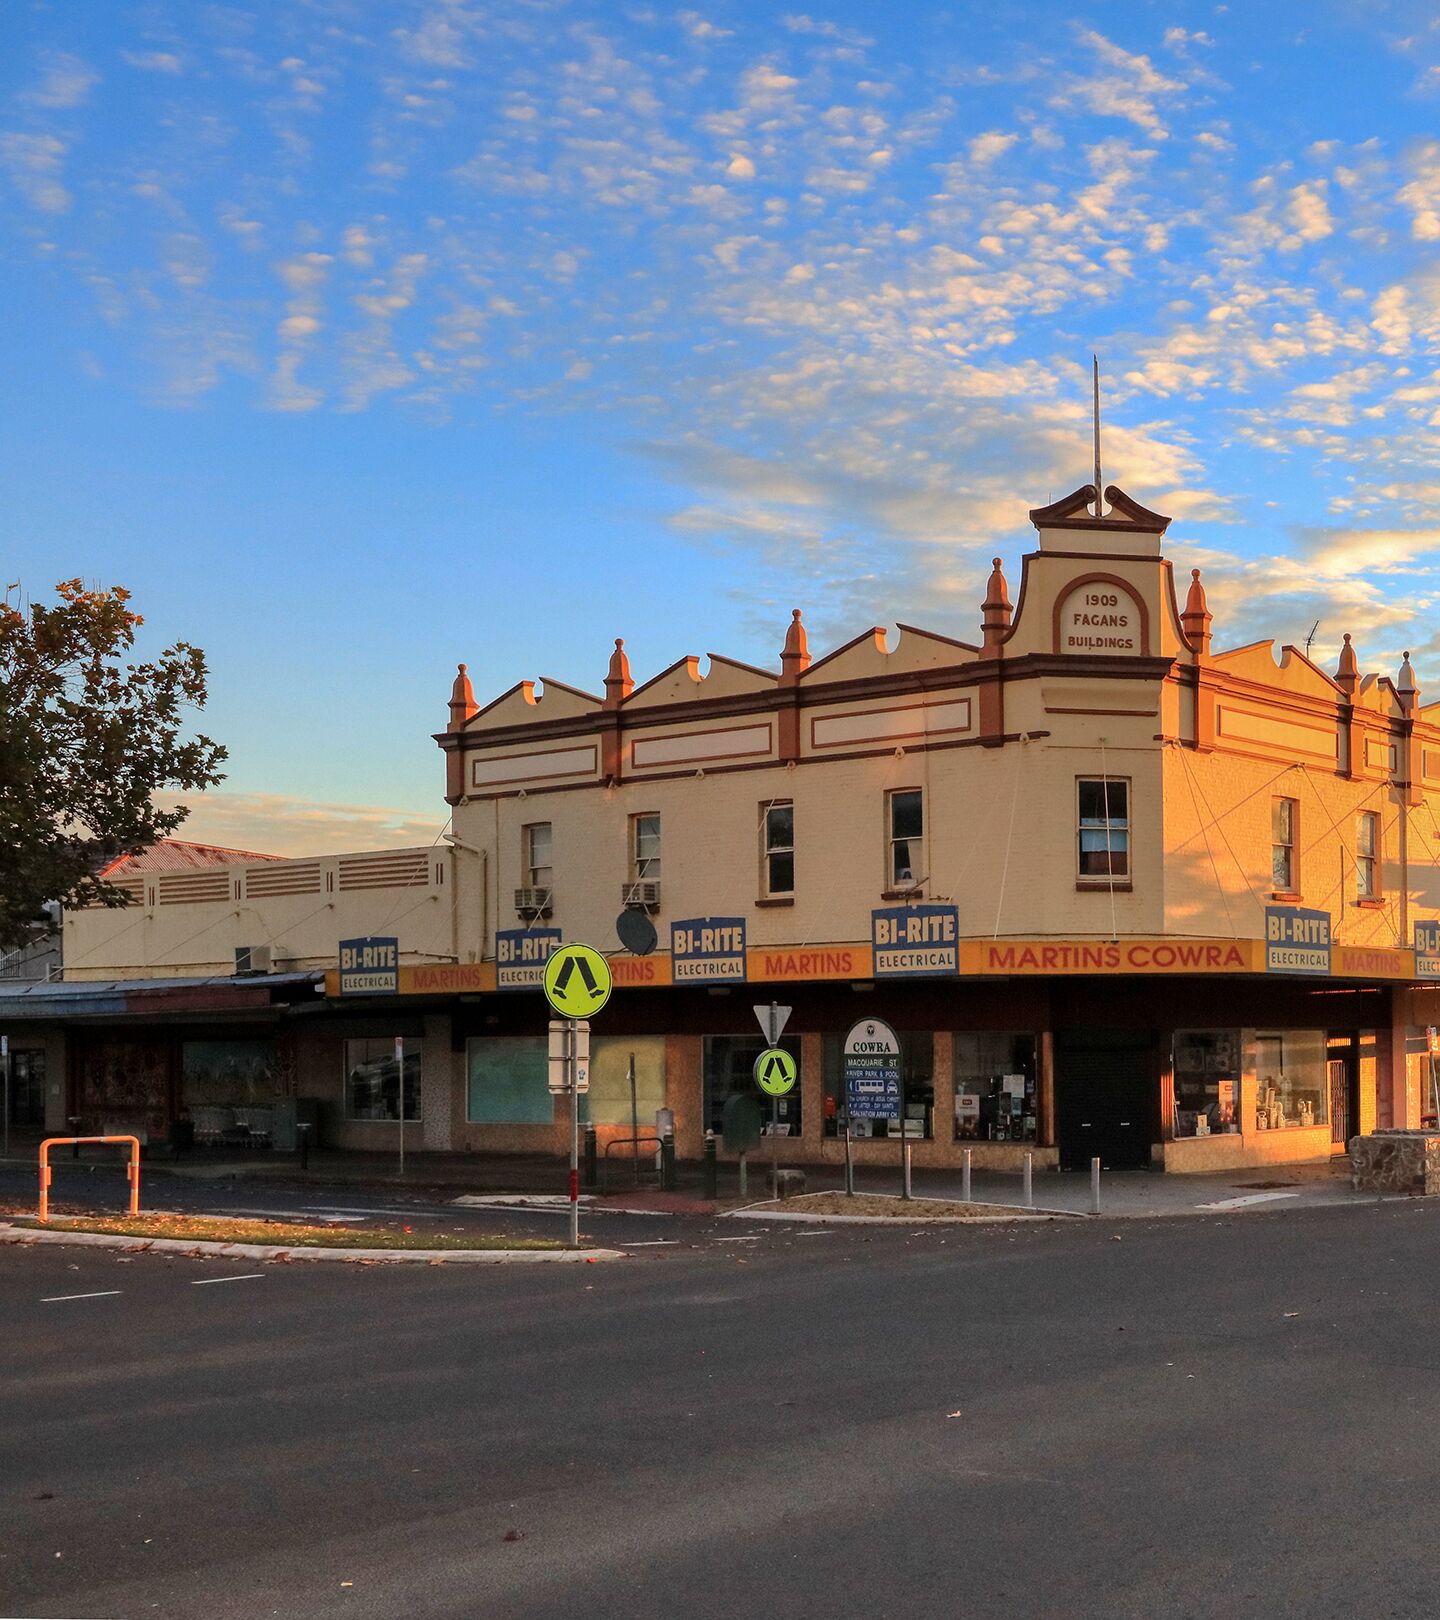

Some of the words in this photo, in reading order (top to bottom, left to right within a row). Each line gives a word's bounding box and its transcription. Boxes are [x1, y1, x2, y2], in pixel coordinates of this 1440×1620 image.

[1086, 594, 1118, 606] 1909
[1073, 613, 1128, 627] FAGANS
[1068, 636, 1133, 649] BUILDINGS
[875, 914, 955, 945] BI-RITE
[1268, 916, 1328, 945] BI-RITE
[673, 927, 743, 954] BI-RITE
[342, 945, 396, 969] BI-RITE
[498, 937, 558, 962] BI-RIT
[989, 946, 1120, 968] MARTINS
[1127, 946, 1245, 968] COWRA
[765, 952, 852, 976] MARTINS
[879, 952, 953, 968] ELECTRICAL
[1271, 952, 1327, 966] ELECTRICAL
[1342, 952, 1400, 973] MARTINS
[501, 970, 544, 982] ELECTRIC
[677, 962, 741, 976] ELECTRICAL
[343, 976, 394, 988] ELECTRICAL
[414, 968, 480, 988] MARTINS
[853, 1042, 891, 1052] COWRA
[889, 1059, 897, 1067] ST
